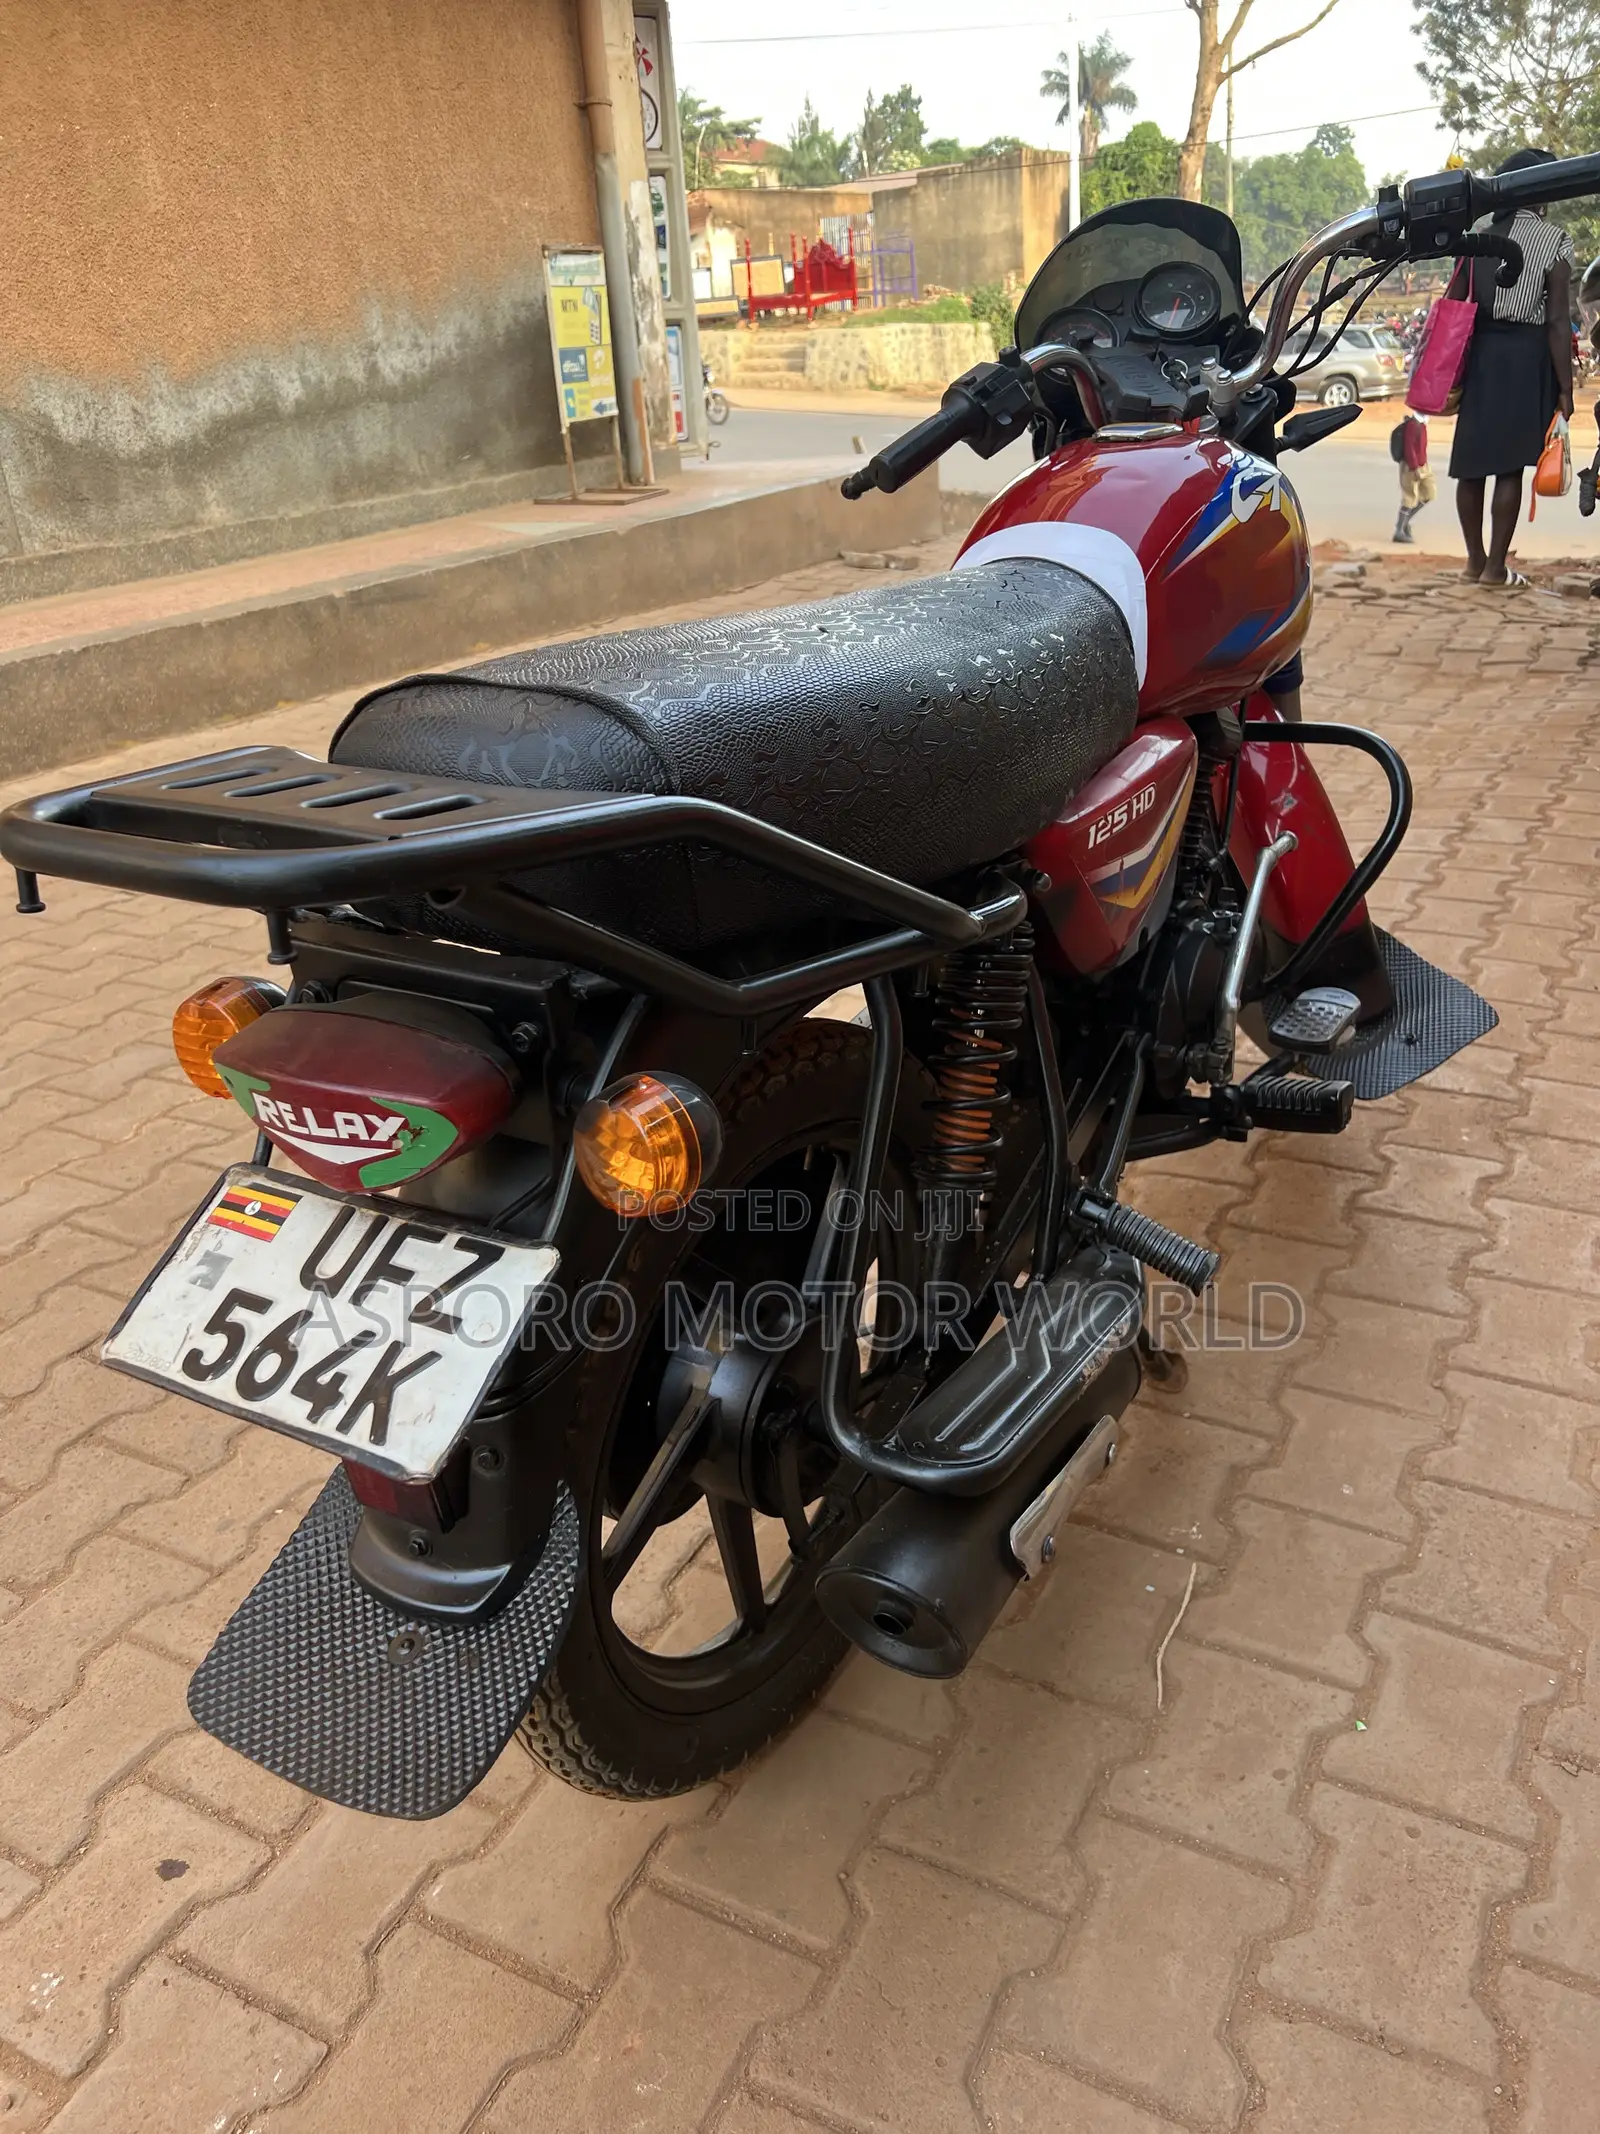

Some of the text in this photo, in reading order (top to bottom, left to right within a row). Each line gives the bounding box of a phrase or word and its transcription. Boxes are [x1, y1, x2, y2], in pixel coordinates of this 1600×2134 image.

[1087, 786, 1156, 850] 125 HD
[299, 1205, 506, 1335] UFZ
[182, 1287, 443, 1446] 564K
